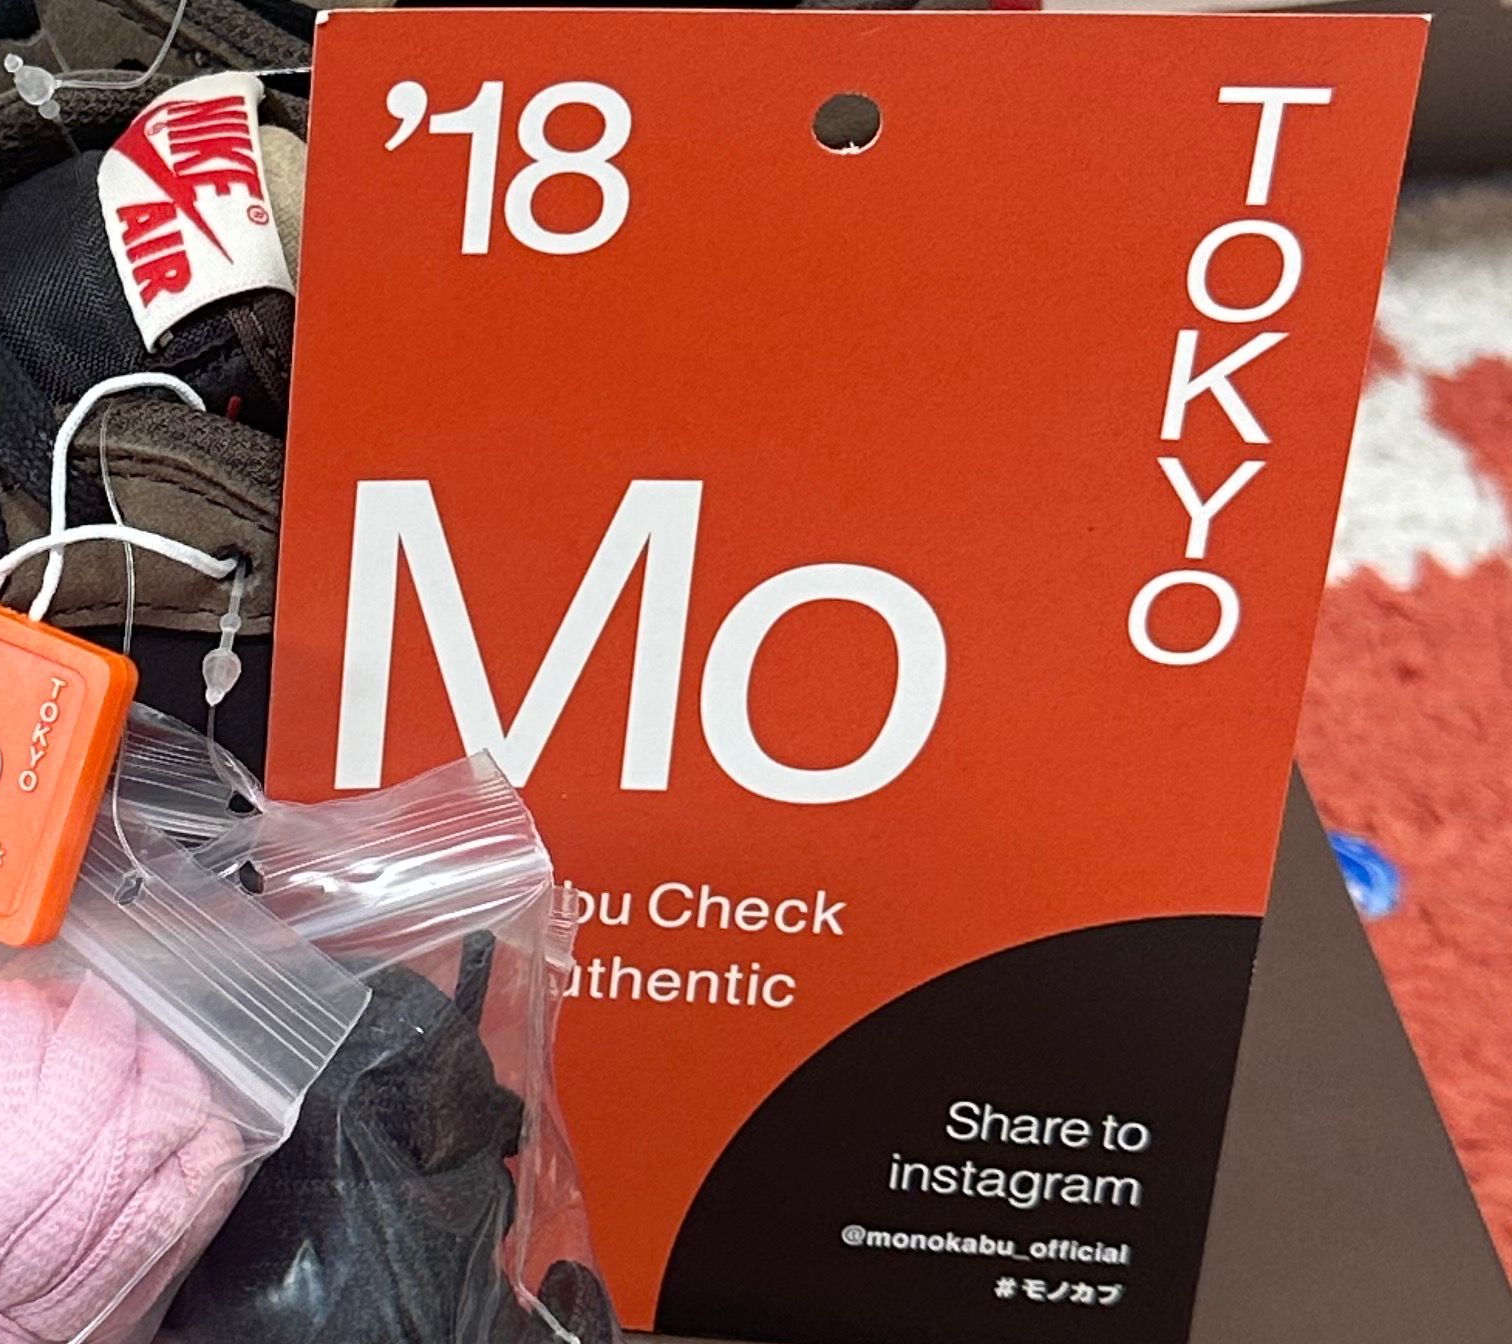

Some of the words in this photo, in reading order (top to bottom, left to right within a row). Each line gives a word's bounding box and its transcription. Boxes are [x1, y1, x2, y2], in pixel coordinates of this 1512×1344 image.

[167, 95, 265, 201] NIKE
[385, 80, 632, 256] '18
[115, 201, 193, 309] AIR
[1125, 86, 1334, 665] TOKYO
[333, 479, 948, 805] Mo
[18, 677, 67, 792] TOKYO
[648, 882, 848, 936] Check
[562, 956, 797, 1009] uthentic
[945, 1101, 1090, 1149] Share
[1100, 1108, 1152, 1153] to
[888, 1153, 1144, 1211] instagram
[840, 1224, 1131, 1265] @monokabu_official
